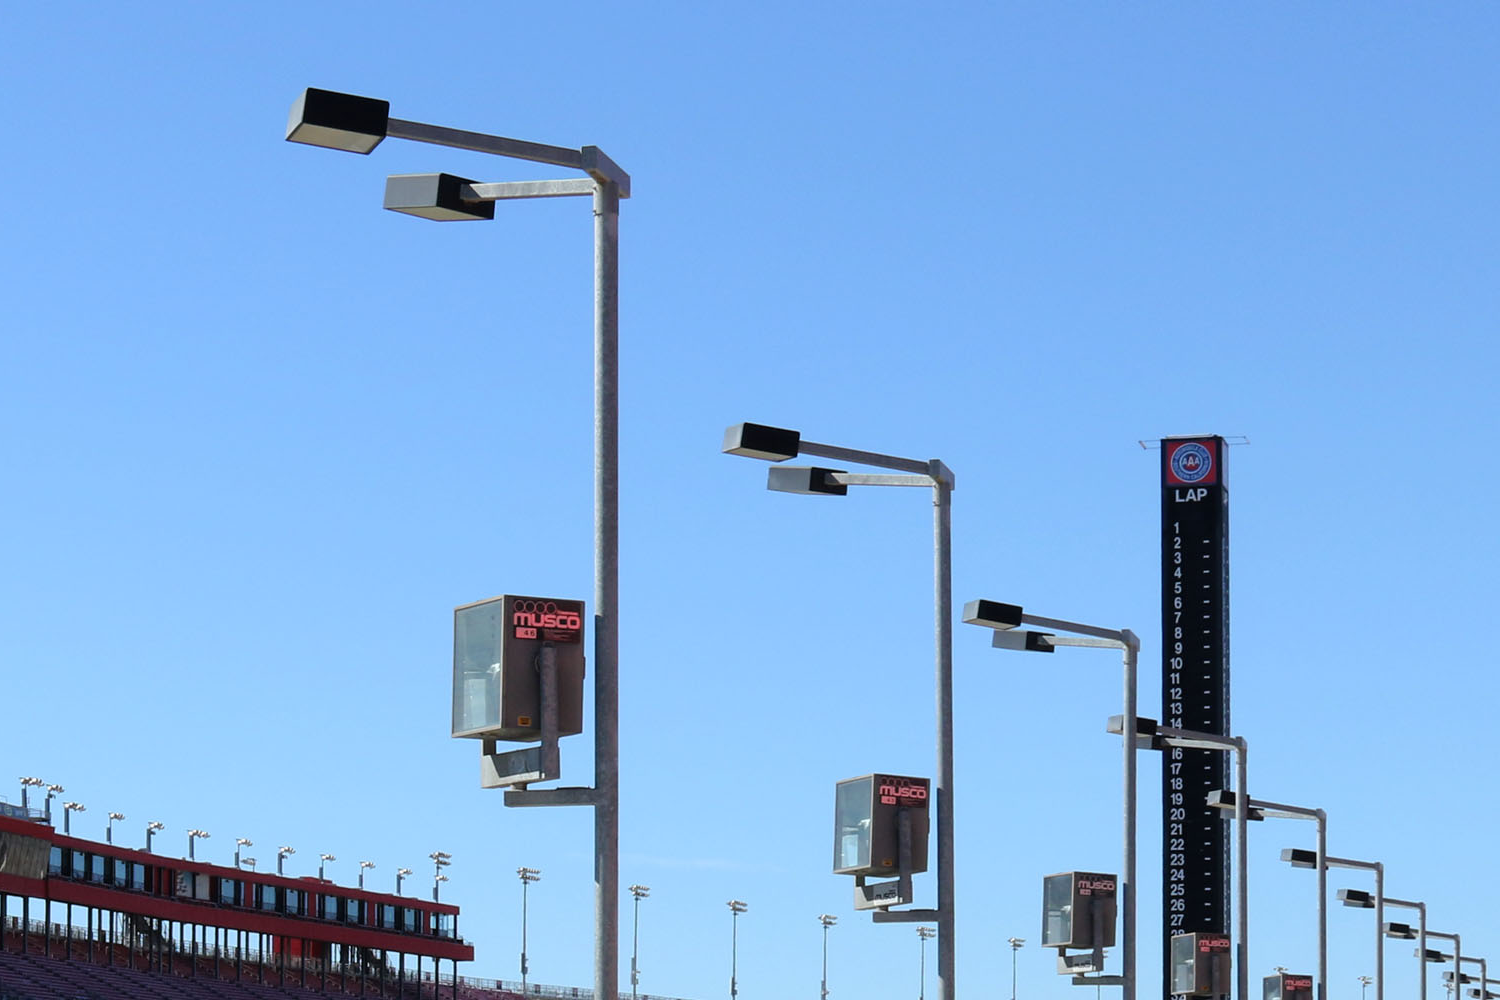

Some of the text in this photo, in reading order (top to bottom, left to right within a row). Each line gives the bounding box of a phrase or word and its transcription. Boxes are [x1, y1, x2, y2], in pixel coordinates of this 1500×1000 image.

[1182, 456, 1200, 467] AAA
[1175, 489, 1208, 502] LAP
[1174, 522, 1179, 533] 1
[1174, 537, 1181, 549] 2
[1174, 552, 1182, 564] 3
[1174, 567, 1182, 579] 4
[1174, 582, 1182, 594] 5
[1174, 597, 1182, 609] 6
[1174, 612, 1182, 624] 7
[1174, 627, 1182, 639] 8
[1174, 642, 1182, 654] 9
[1170, 657, 1182, 669] 10
[1170, 672, 1180, 684] 11
[1170, 688, 1182, 700] 12
[1170, 703, 1182, 715] 13
[1170, 749, 1182, 761] 16
[1170, 763, 1182, 775] 17
[1170, 778, 1182, 790] 18
[1170, 793, 1182, 805] 19
[1170, 808, 1185, 820] 20
[1170, 824, 1182, 836] 21
[1170, 839, 1185, 851] 22
[1170, 854, 1185, 866] 23
[1170, 869, 1185, 881] 24
[1170, 884, 1185, 896] 25
[1170, 899, 1185, 911] 26
[1170, 914, 1185, 926] 27
